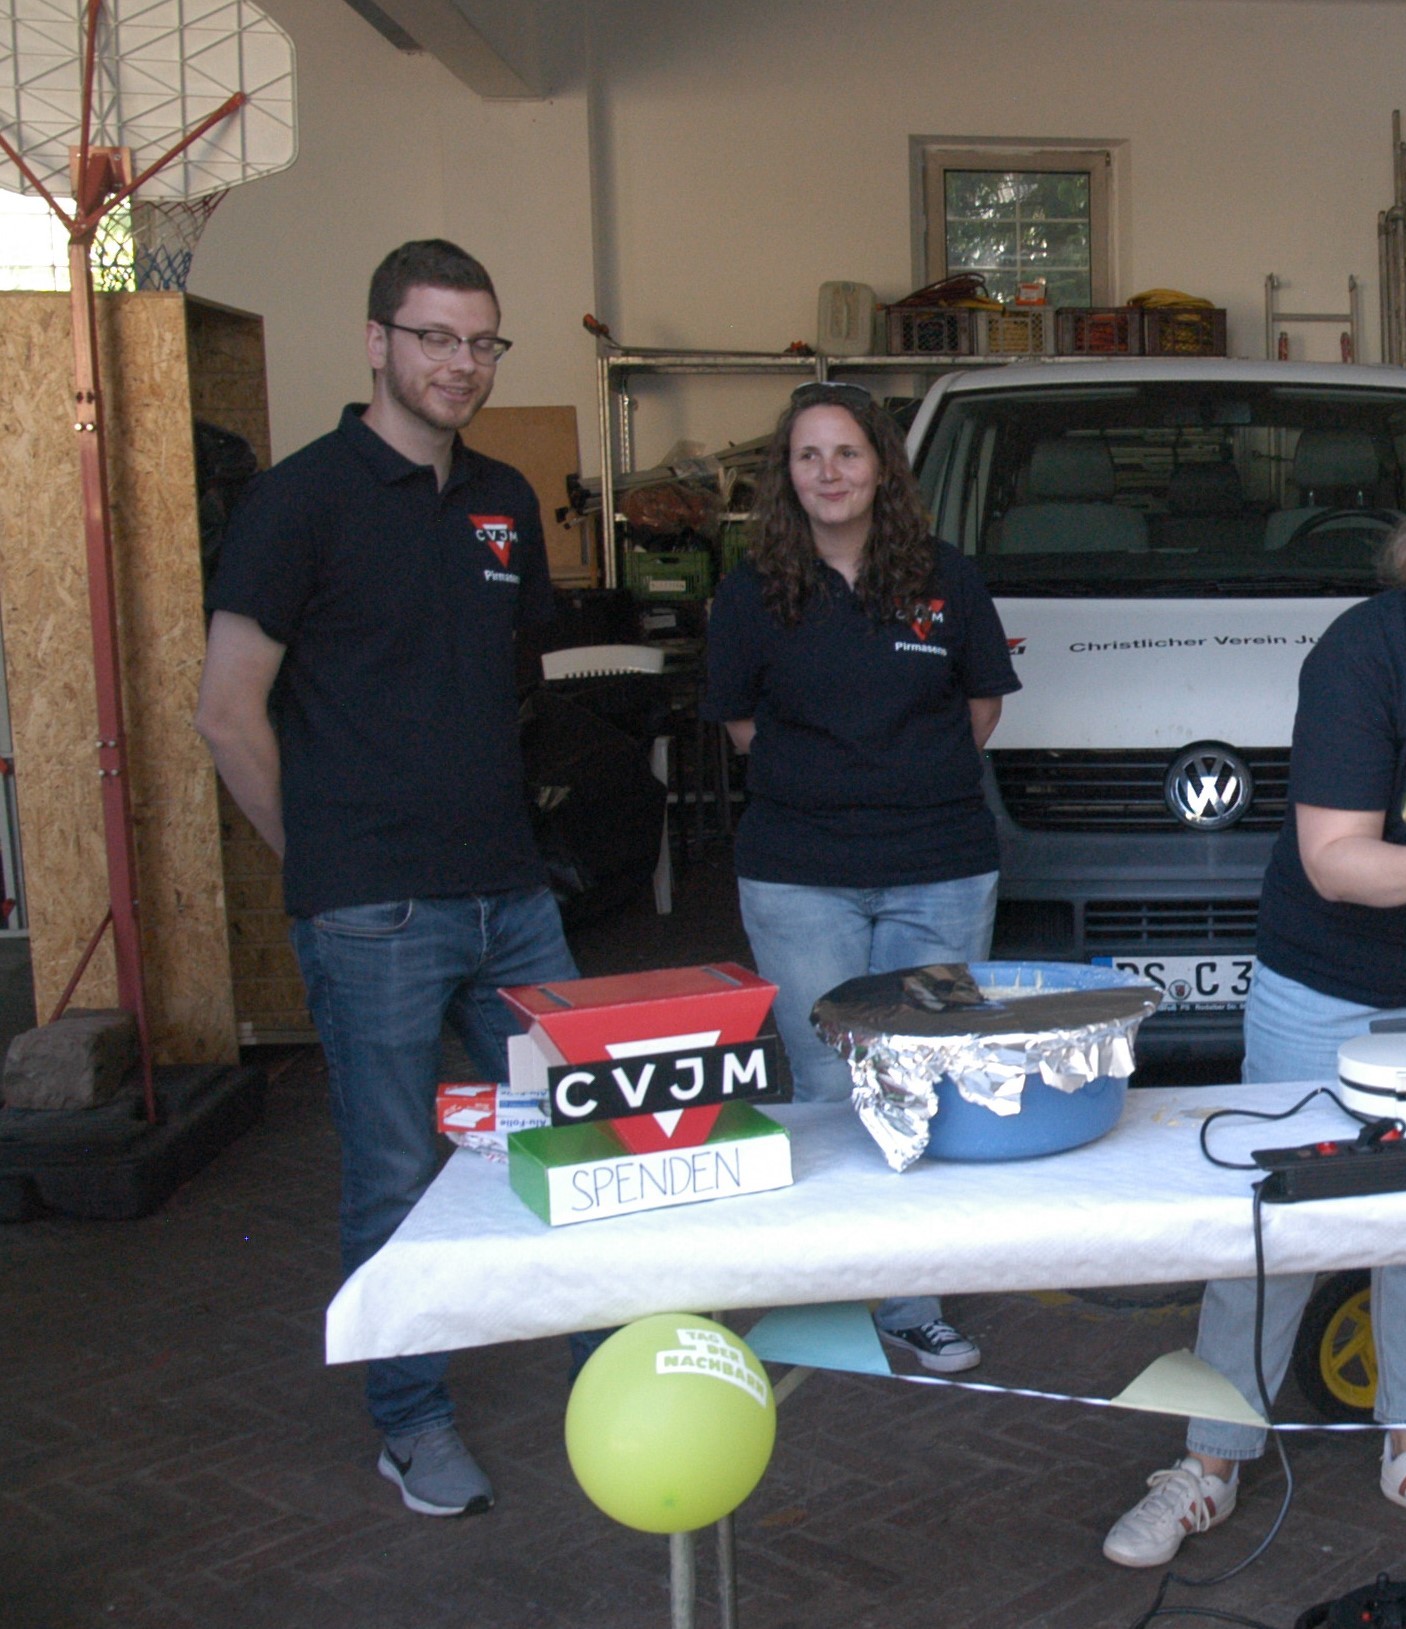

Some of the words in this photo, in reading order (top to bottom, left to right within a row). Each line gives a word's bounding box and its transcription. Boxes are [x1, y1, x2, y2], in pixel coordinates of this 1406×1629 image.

[475, 529, 518, 542] CVJM
[1069, 637, 1207, 653] Christlicher
[1214, 635, 1288, 646] Verein
[1295, 635, 1321, 645] Ju
[1196, 962, 1219, 996] C
[1231, 961, 1253, 995] 3
[556, 1049, 768, 1118] CVJM
[571, 1147, 741, 1212] SPENDEN
[686, 1332, 719, 1344] TAG
[707, 1344, 739, 1361] DER
